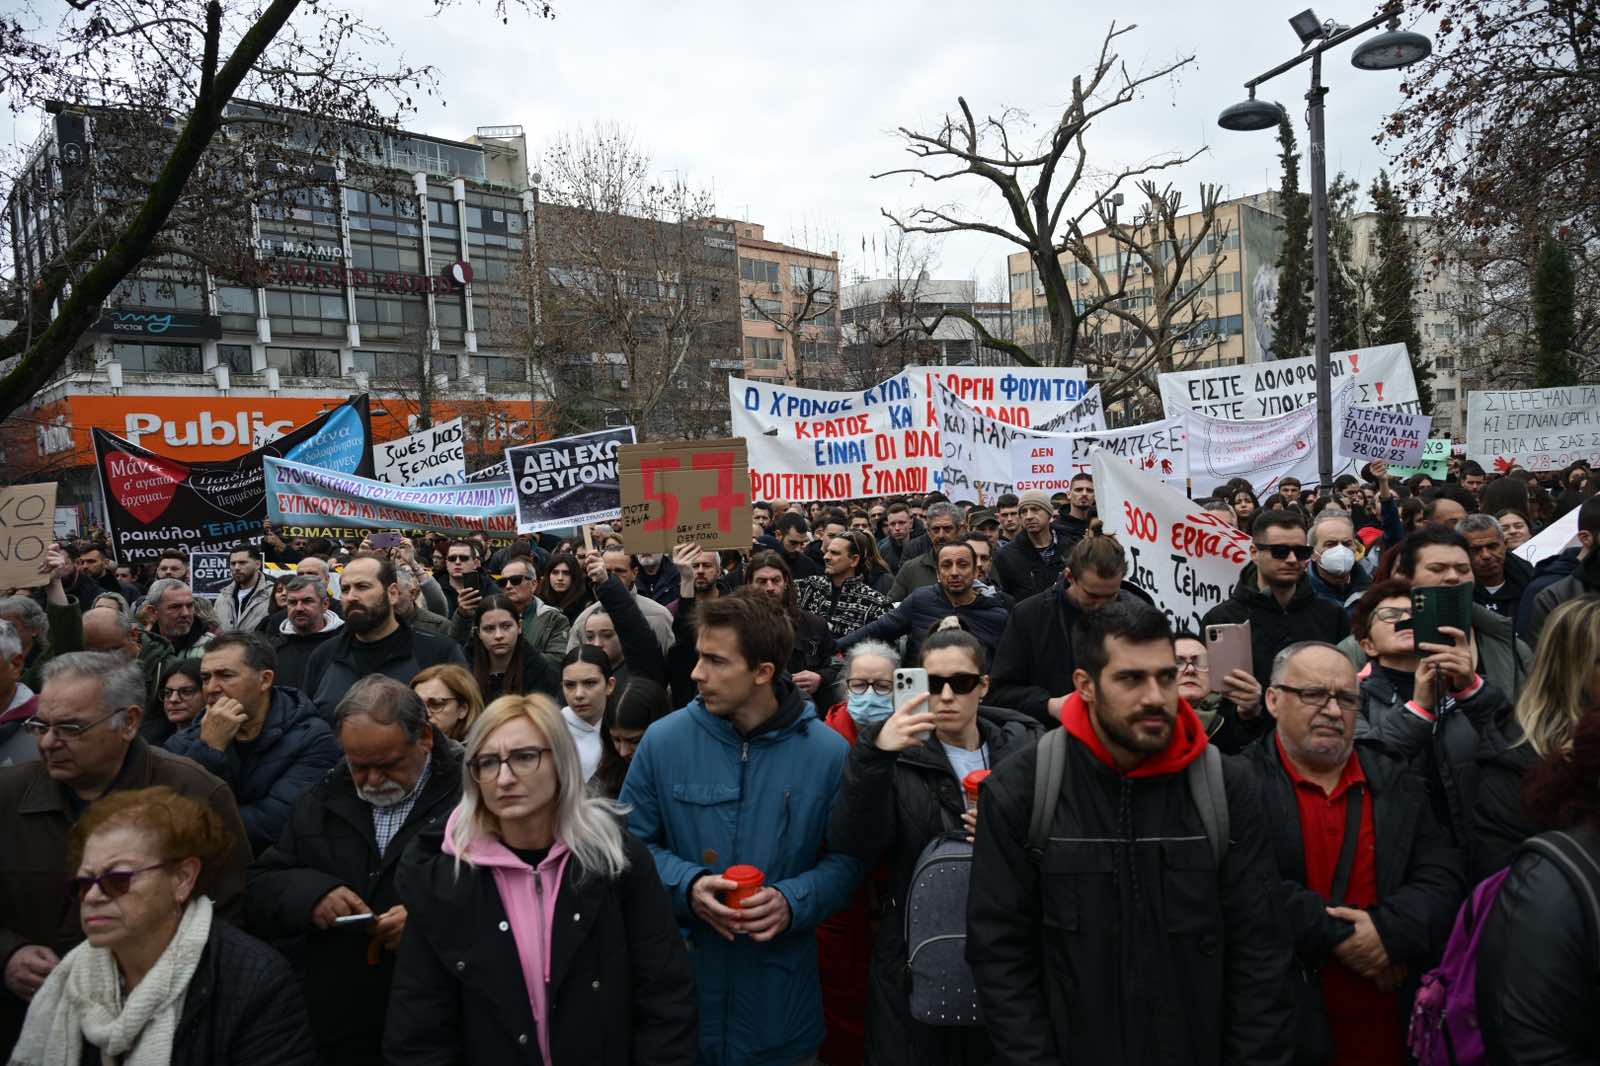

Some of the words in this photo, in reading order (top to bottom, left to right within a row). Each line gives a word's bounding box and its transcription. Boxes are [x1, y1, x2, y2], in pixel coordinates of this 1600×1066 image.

[1188, 375, 1244, 401] ΕΙΣΤΕ
[1255, 354, 1360, 392] ΔΟΛΟΦΟΟΙ!
[745, 386, 760, 411] Ο
[770, 391, 853, 417] ΧΡΟΝΟΣ
[947, 374, 995, 401] ΟΡΓΗ
[1000, 373, 1088, 402] ΦΟΥΝΤΩΝ
[1484, 390, 1572, 412] ΣΤΕΡΕΨΑΝ
[1580, 387, 1597, 405] ΤΑ
[795, 413, 873, 439] ΚΡΑΤΟΣ
[944, 412, 965, 434] ΚΑΙ
[1347, 407, 1414, 426] ΣΤΕΡΕΨΑΝ
[1484, 416, 1500, 433] ΚΙ
[1507, 414, 1559, 430] ΕΓΙΝΑΝ
[1561, 411, 1591, 426] ΟΡΓΗ
[1343, 429, 1388, 447] ΕΓΙΝΑΝ
[1391, 438, 1419, 449] ΟΡΓΗ
[1344, 418, 1358, 430] ΤΑ
[1359, 422, 1397, 437] ΔΑΚΡΥΑ
[1401, 429, 1420, 440] ΚΑΙ
[814, 439, 866, 466] ΕΙΝΑΙ
[875, 434, 897, 461] ΟΙ
[1031, 448, 1054, 457] ΔΕΝ
[1352, 441, 1406, 461] 28/02/23
[1424, 442, 1444, 454] ΧΩ
[1484, 437, 1528, 456] ΓΕΝΙΑ
[1534, 436, 1550, 451] ΔΕ
[1558, 434, 1584, 449] ΣΑΣ
[111, 458, 163, 478] Μάνα
[524, 449, 571, 475] ΔΕΝ
[575, 440, 621, 465] ΕΧΩ
[1031, 464, 1055, 473] ΕΧΩ
[520, 461, 620, 495] ΟΞΥΓΟΝ
[749, 469, 851, 500] ΦΟΙΤΗΤΙΚΟΙ
[1017, 480, 1070, 490] ΟΞΥΓΟΝΟ
[366, 485, 393, 501] ΤΟΥ
[393, 488, 455, 505] ΚΕΡΔΟΥΣ
[456, 488, 496, 507] ΚΑΜΙΑ
[640, 452, 747, 534] 57
[277, 492, 358, 517] ΣΥΓΚΡΟΥΣΗ
[454, 513, 484, 532] ΤΗΝ
[487, 512, 517, 532] ΑΝΑ
[623, 503, 650, 514] ΠΟΤΕ
[119, 526, 200, 544] ραικύλοι
[202, 519, 263, 537] Έλλη
[281, 526, 369, 538] ΣΩΜΑΤΕΙΟ
[1124, 500, 1158, 542] 300
[194, 569, 231, 578] ΟΞΥΓ
[199, 558, 227, 568] ΔΕΝ
